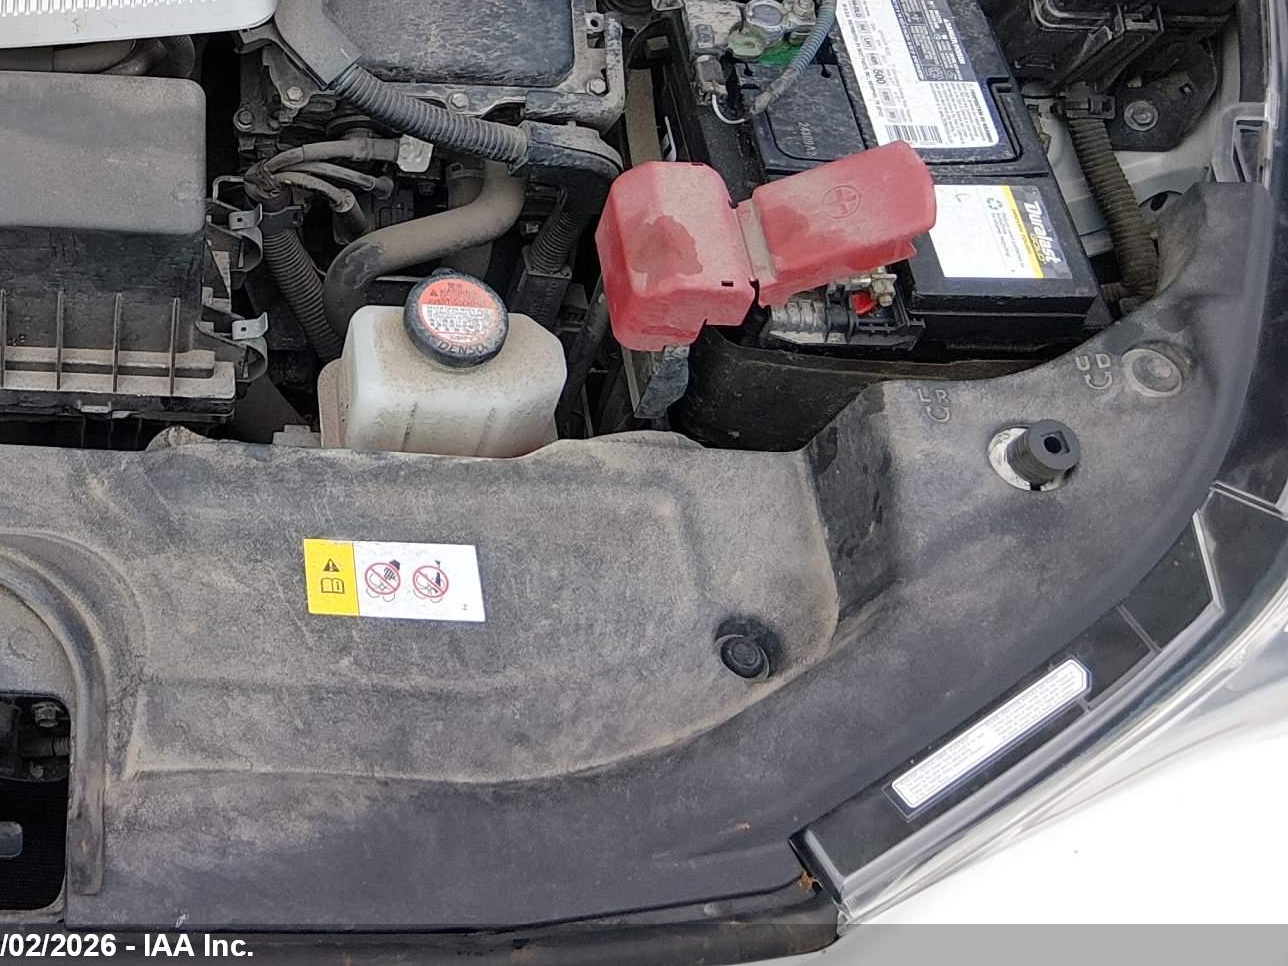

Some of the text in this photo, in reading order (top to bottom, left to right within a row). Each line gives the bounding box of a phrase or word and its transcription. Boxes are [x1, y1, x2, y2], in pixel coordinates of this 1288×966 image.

[872, 68, 887, 85] 500
[1024, 200, 1061, 264] Duralast
[1030, 233, 1047, 264] GOLD
[438, 340, 485, 354] DENSO
